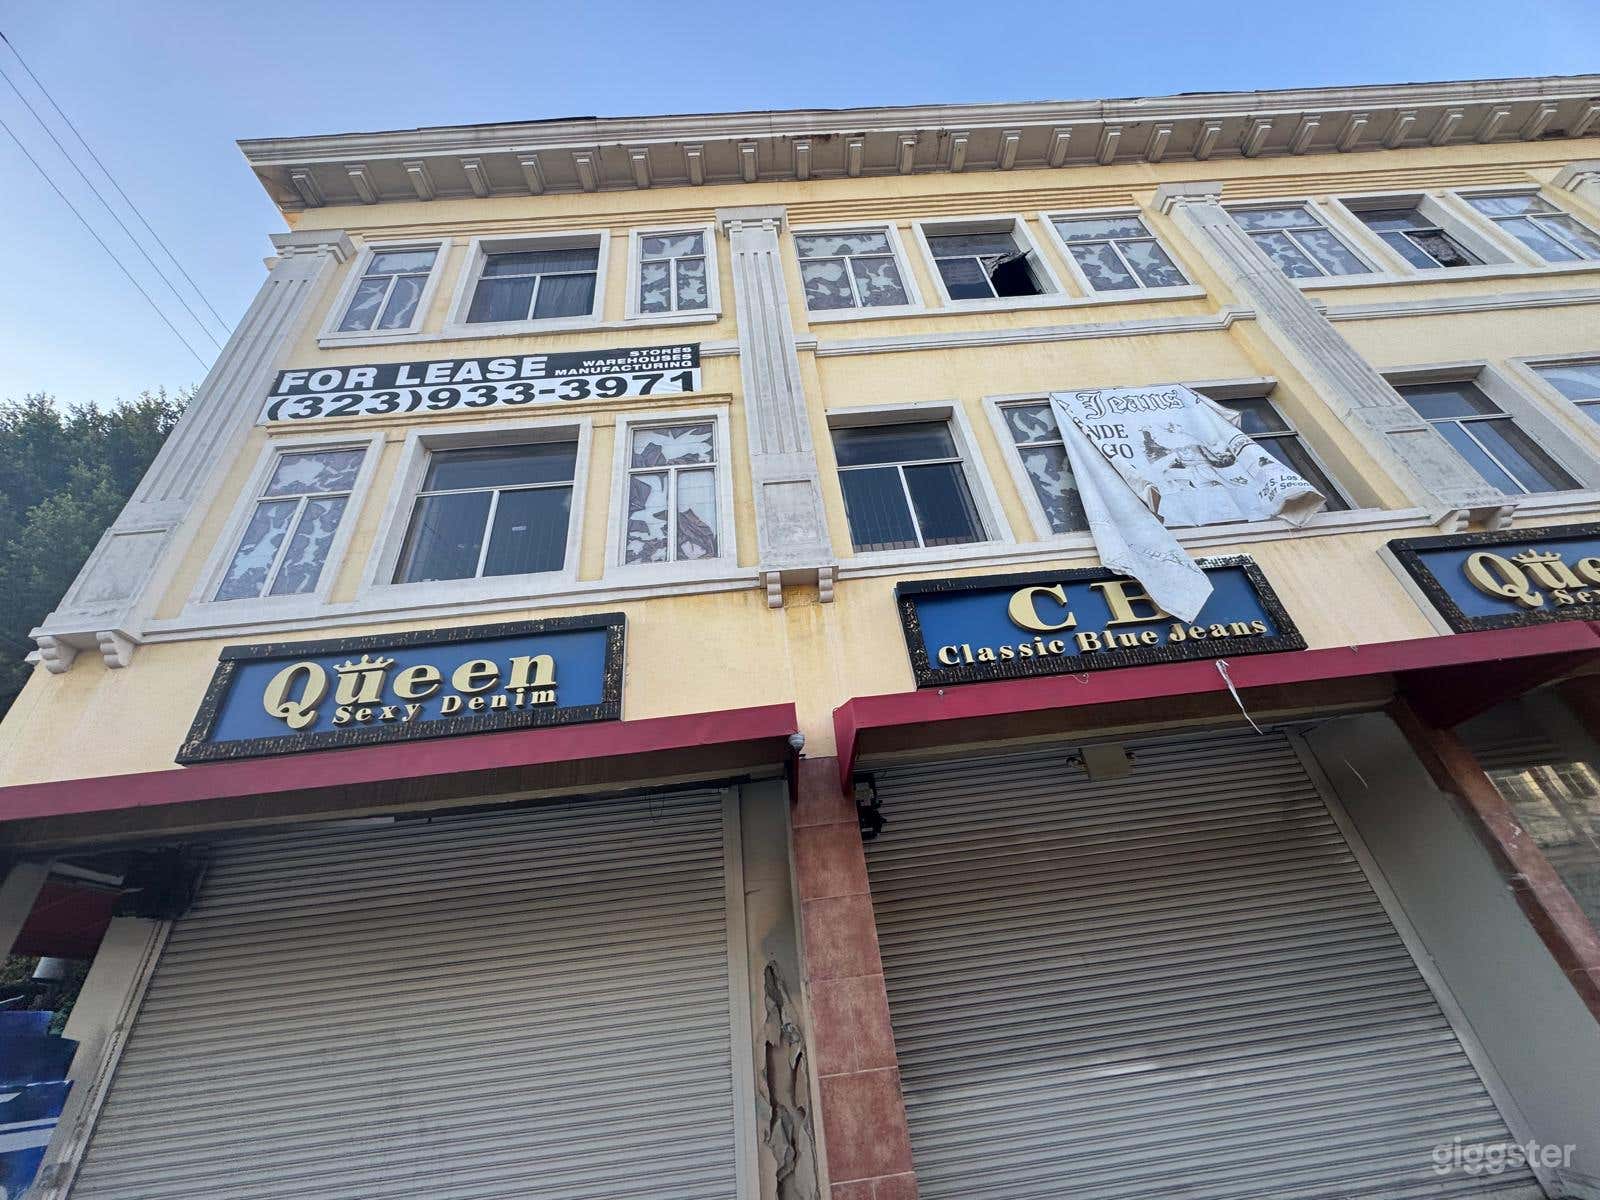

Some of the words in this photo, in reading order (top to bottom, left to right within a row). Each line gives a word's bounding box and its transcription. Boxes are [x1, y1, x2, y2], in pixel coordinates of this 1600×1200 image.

[554, 360, 692, 376] MANUFACTURING
[582, 353, 692, 367] WAREHOUSES
[630, 347, 692, 357] STORES
[277, 366, 378, 394] FOR
[395, 357, 547, 386] LEASE
[267, 370, 694, 421] (323)933-3971
[1075, 390, 1185, 419] Jeans
[938, 636, 1066, 666] Classic
[1075, 629, 1159, 653] Blue
[1169, 618, 1268, 643] Jeans
[263, 650, 558, 730] Queen
[332, 703, 423, 725] Sexy
[441, 687, 557, 715] Denim
